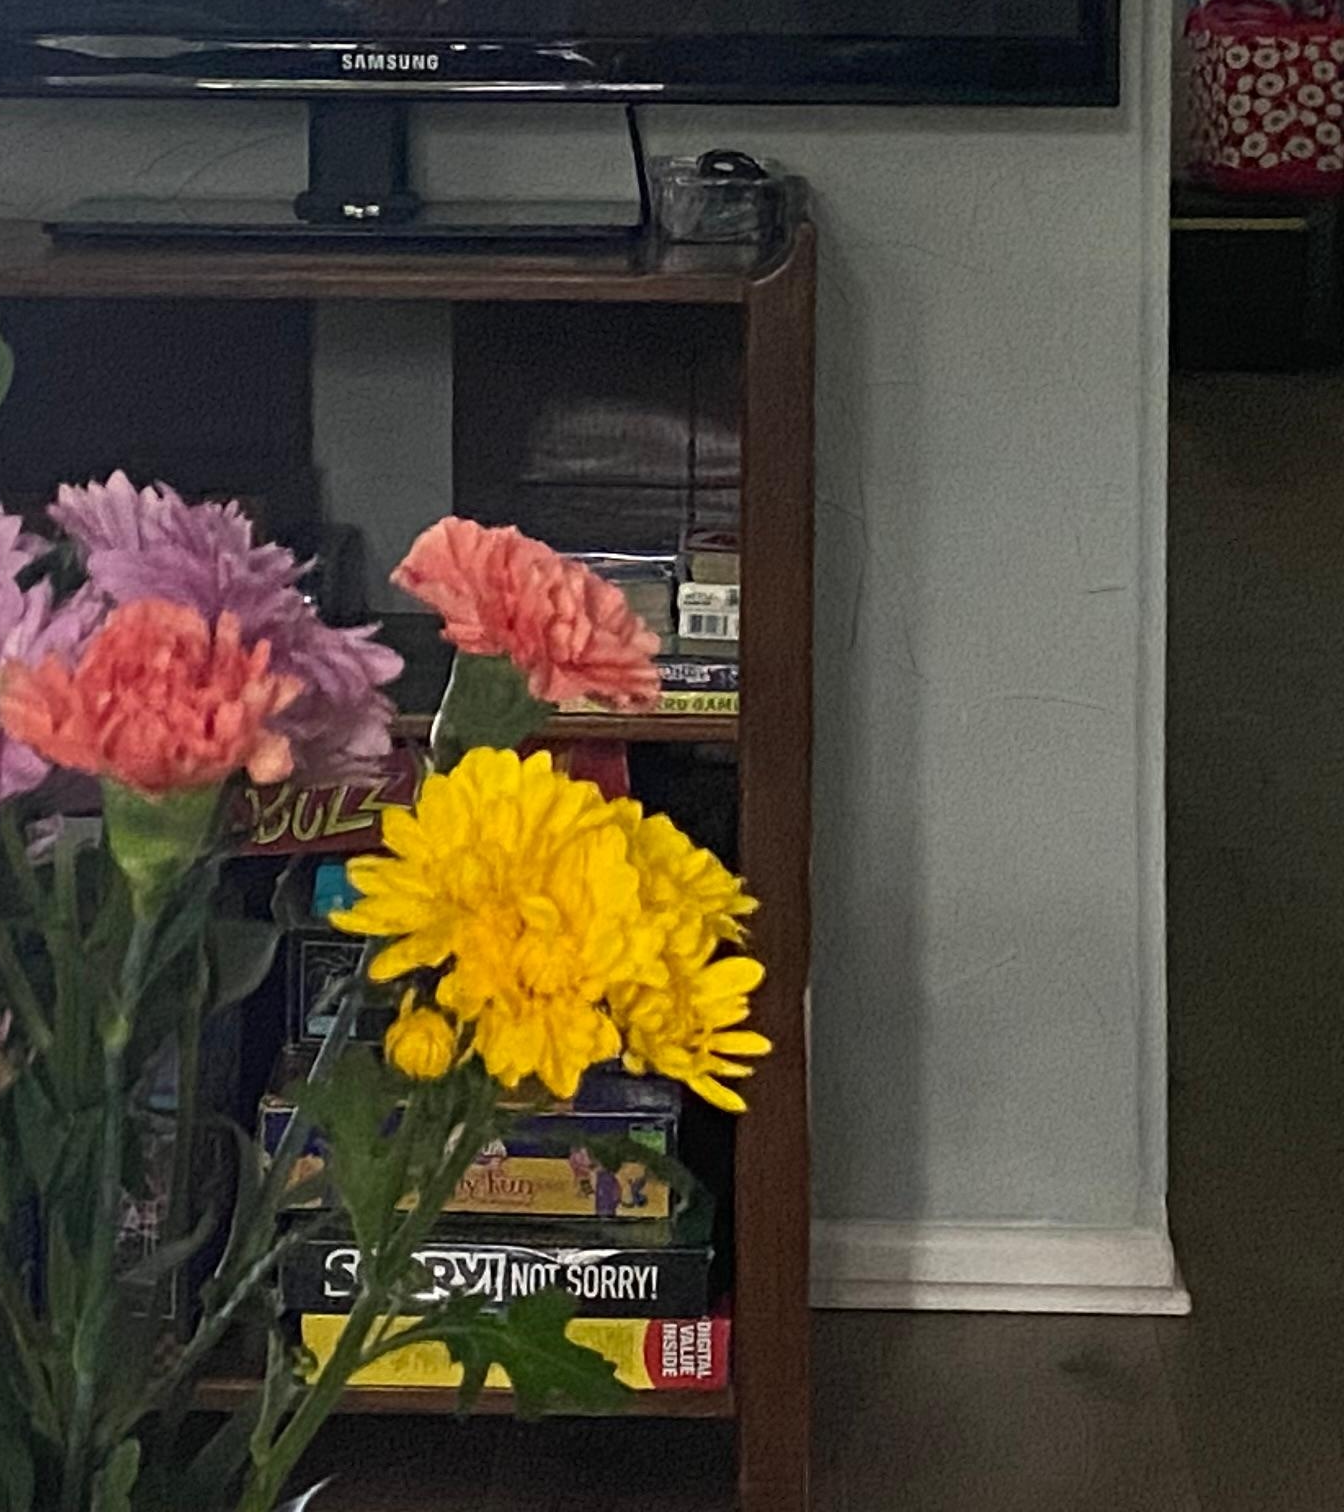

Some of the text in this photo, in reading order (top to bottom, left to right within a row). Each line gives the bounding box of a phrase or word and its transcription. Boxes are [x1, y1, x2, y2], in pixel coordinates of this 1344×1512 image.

[342, 53, 440, 71] SAMSUNG
[511, 1261, 561, 1296] NOT
[567, 1264, 659, 1301] SORRY!
[662, 1323, 678, 1377] INSIDE
[679, 1324, 695, 1377] VALUE
[696, 1321, 712, 1379] DIGITAL
